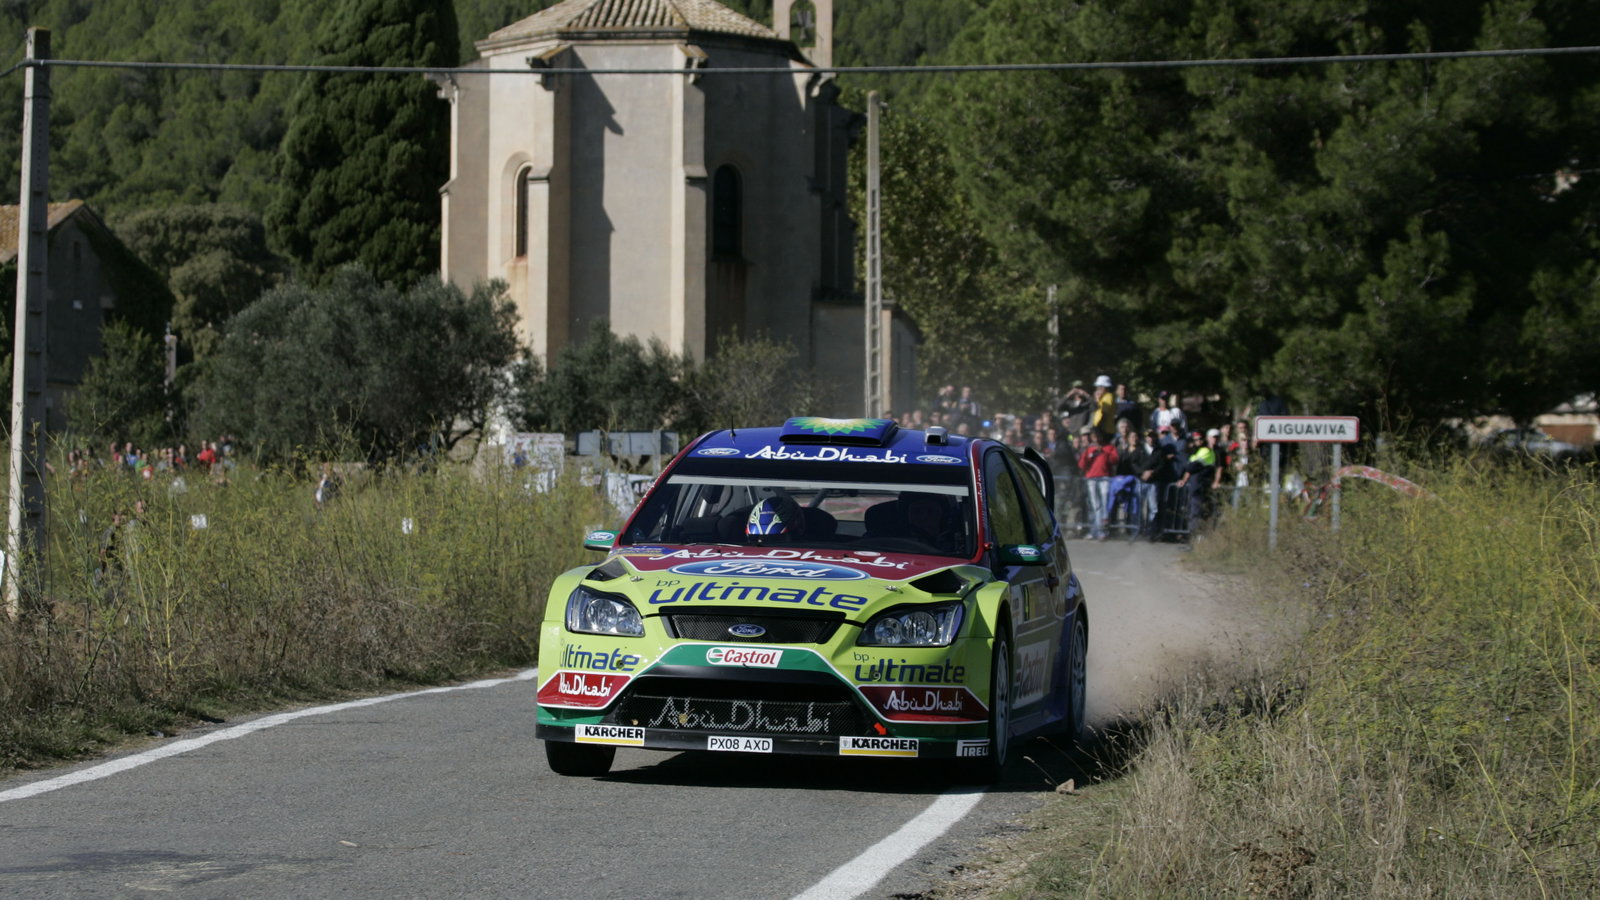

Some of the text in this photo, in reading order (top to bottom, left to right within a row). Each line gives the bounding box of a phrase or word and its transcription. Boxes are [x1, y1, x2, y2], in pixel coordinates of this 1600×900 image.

[1267, 423, 1347, 435] AIGUAVIVA
[703, 448, 738, 457] Ford
[920, 455, 956, 464] Ford
[702, 561, 834, 578] Ford
[655, 579, 681, 588] bp
[649, 582, 869, 611] ultimate
[723, 649, 777, 665] Castrol
[853, 652, 870, 662] bp
[854, 657, 966, 683] ultimate
[584, 725, 644, 740] KÄRCHER
[709, 738, 771, 751] PX08 AXD
[851, 737, 918, 750] KÄRCHER
